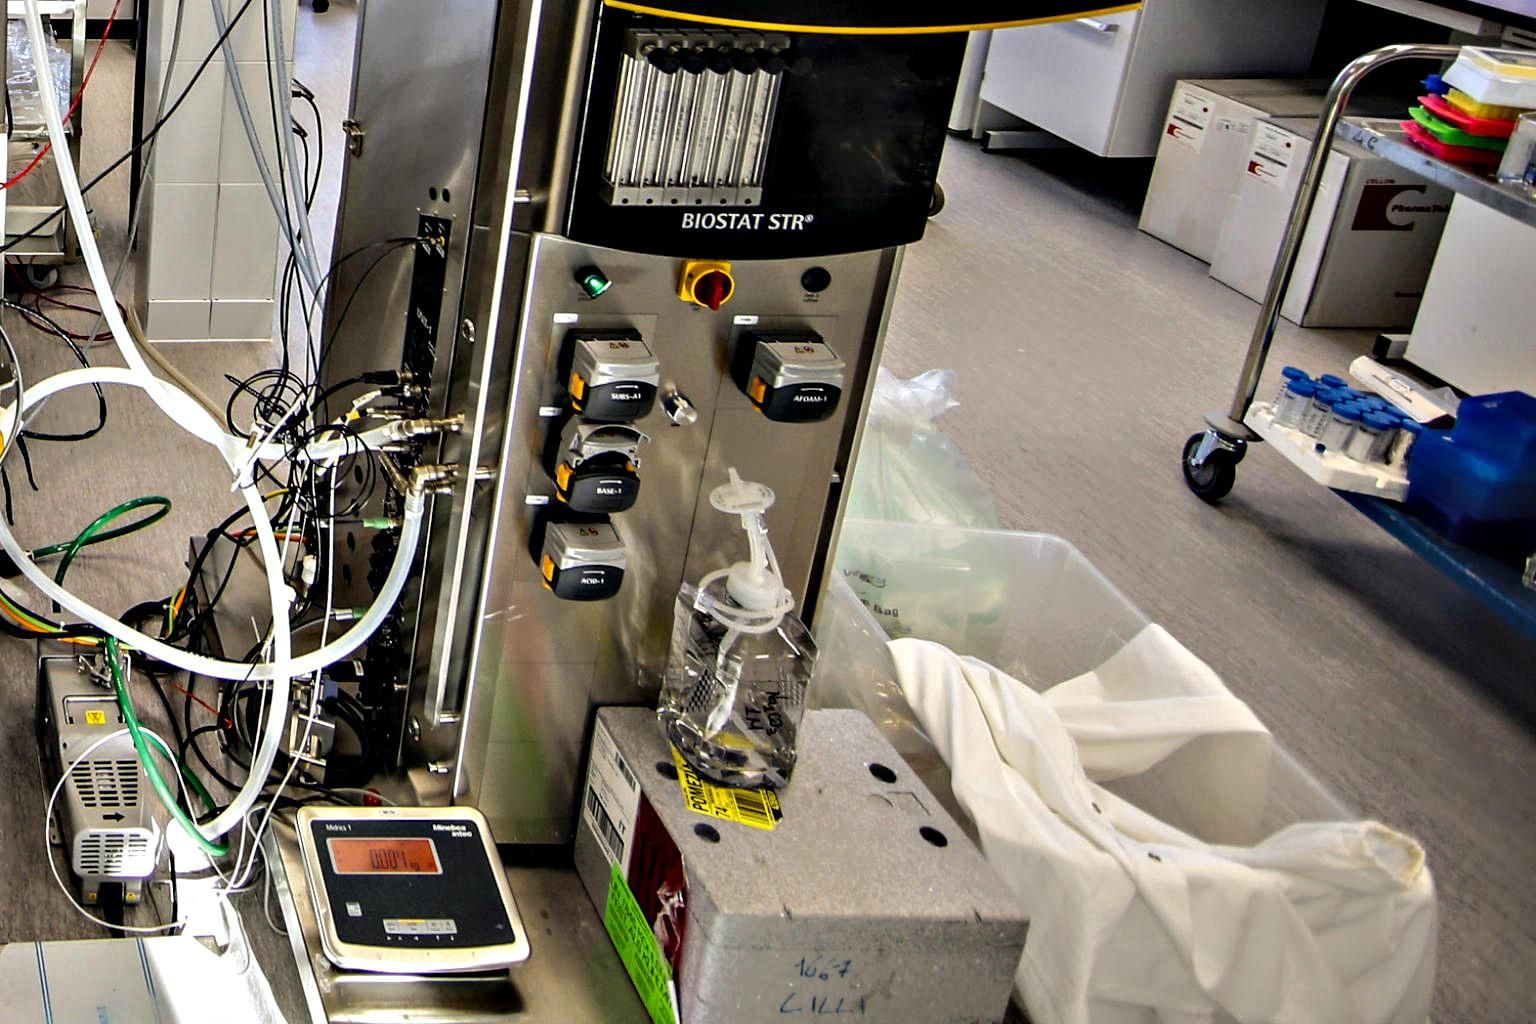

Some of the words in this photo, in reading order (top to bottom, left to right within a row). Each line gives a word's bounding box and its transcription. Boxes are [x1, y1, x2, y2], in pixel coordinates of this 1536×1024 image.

[681, 212, 765, 230] BIOSTAT
[596, 487, 622, 495] BASE-1
[683, 761, 708, 813] POMEZI
[432, 823, 467, 831] Minebea
